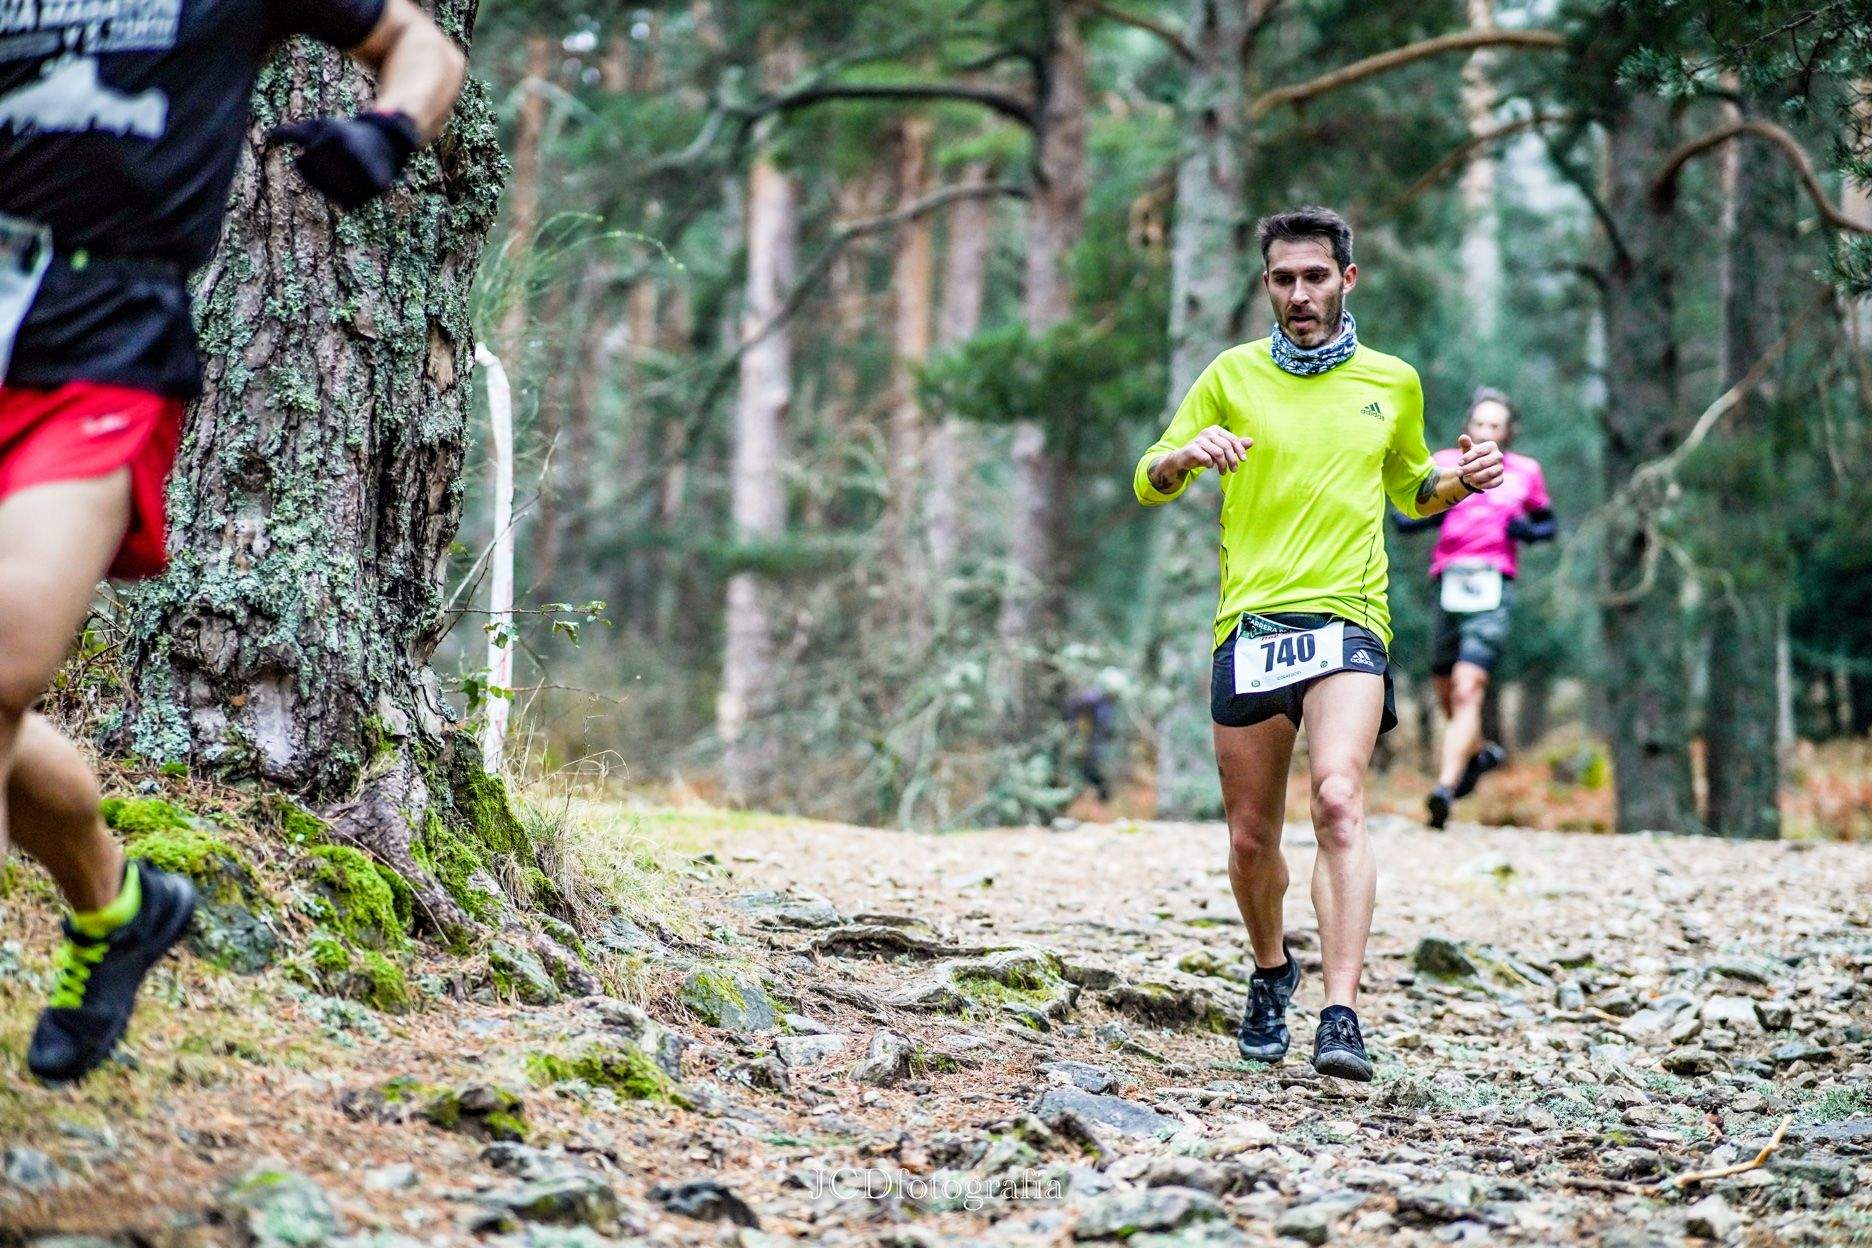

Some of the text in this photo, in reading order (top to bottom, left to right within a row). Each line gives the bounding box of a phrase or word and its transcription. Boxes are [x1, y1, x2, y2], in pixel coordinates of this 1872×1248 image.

[1360, 410, 1384, 421] adidas
[1260, 633, 1315, 672] 740
[1350, 657, 1374, 667] adidas
